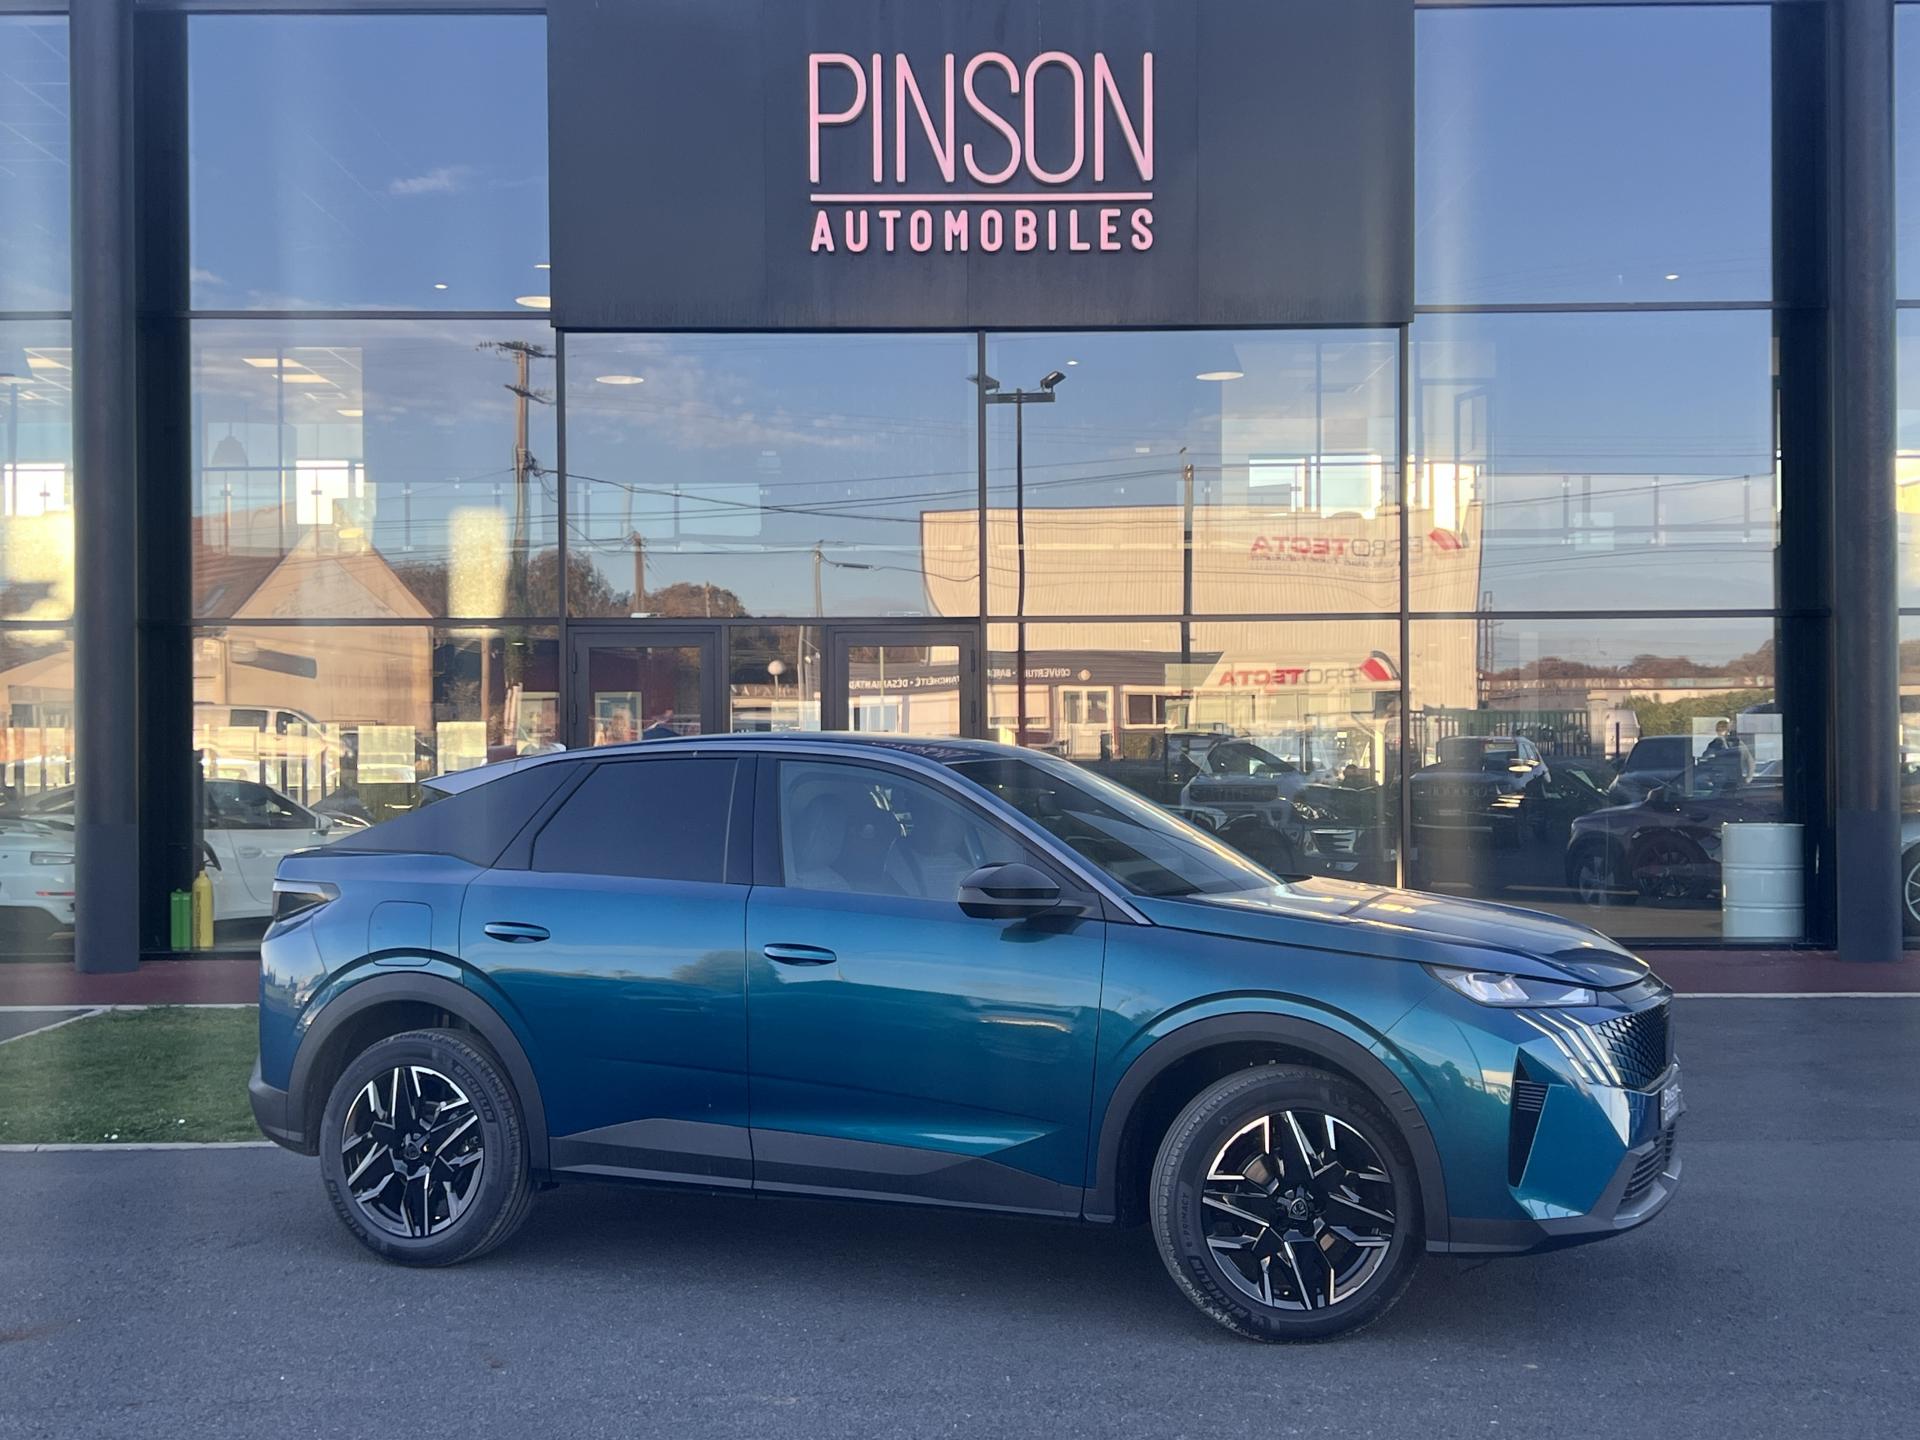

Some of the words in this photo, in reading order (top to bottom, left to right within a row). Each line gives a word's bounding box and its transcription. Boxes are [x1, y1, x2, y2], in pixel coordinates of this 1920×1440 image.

[809, 51, 1153, 184] PINSON
[811, 208, 1153, 252] AUTOMOBILES
[454, 1065, 495, 1121] MICHELIN
[1191, 1257, 1248, 1318] MICHELIN
